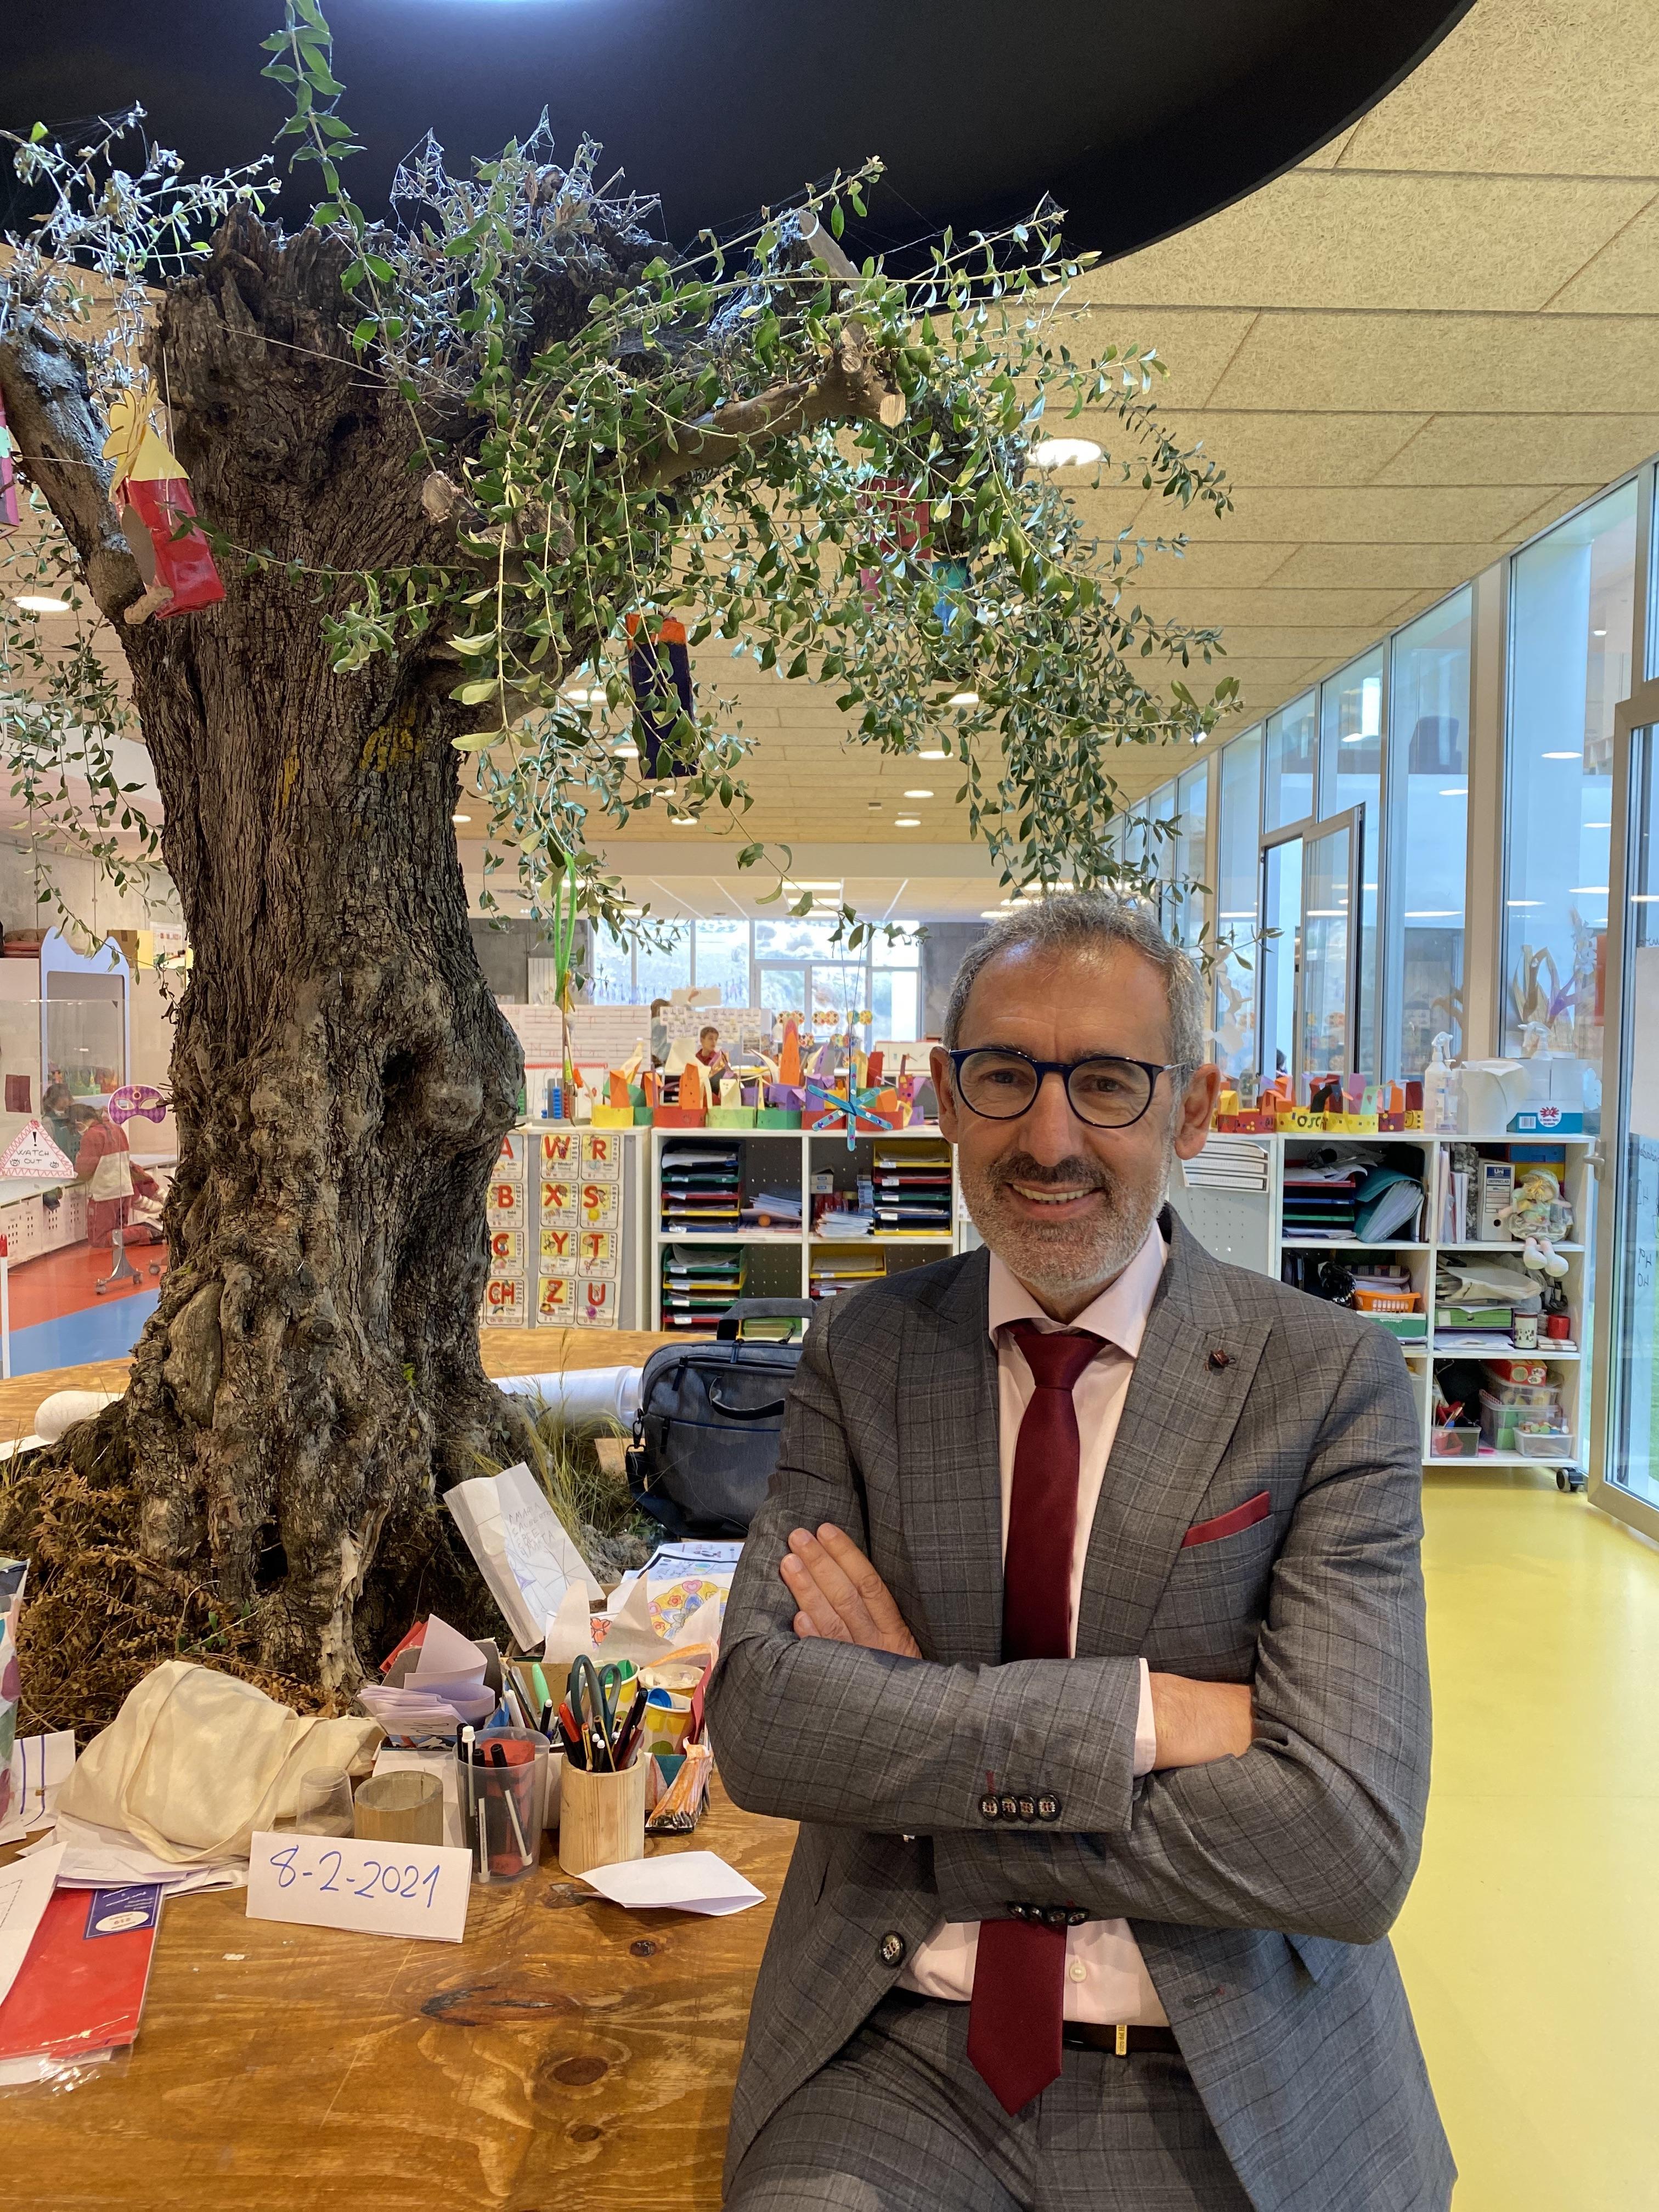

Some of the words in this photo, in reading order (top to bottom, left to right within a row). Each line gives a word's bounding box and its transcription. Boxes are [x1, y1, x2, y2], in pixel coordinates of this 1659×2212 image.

[500, 1136, 514, 1160] A
[544, 1135, 571, 1160] W
[591, 1139, 607, 1160] R
[498, 1184, 514, 1208] B
[544, 1183, 563, 1207] X
[583, 1185, 599, 1209] S
[493, 1233, 510, 1257] C
[551, 1231, 568, 1255] Y
[589, 1233, 604, 1257] T
[488, 1281, 515, 1305] CH
[547, 1279, 563, 1304] Z
[588, 1282, 606, 1306] U
[270, 1844, 441, 1909] 8-2-2021
